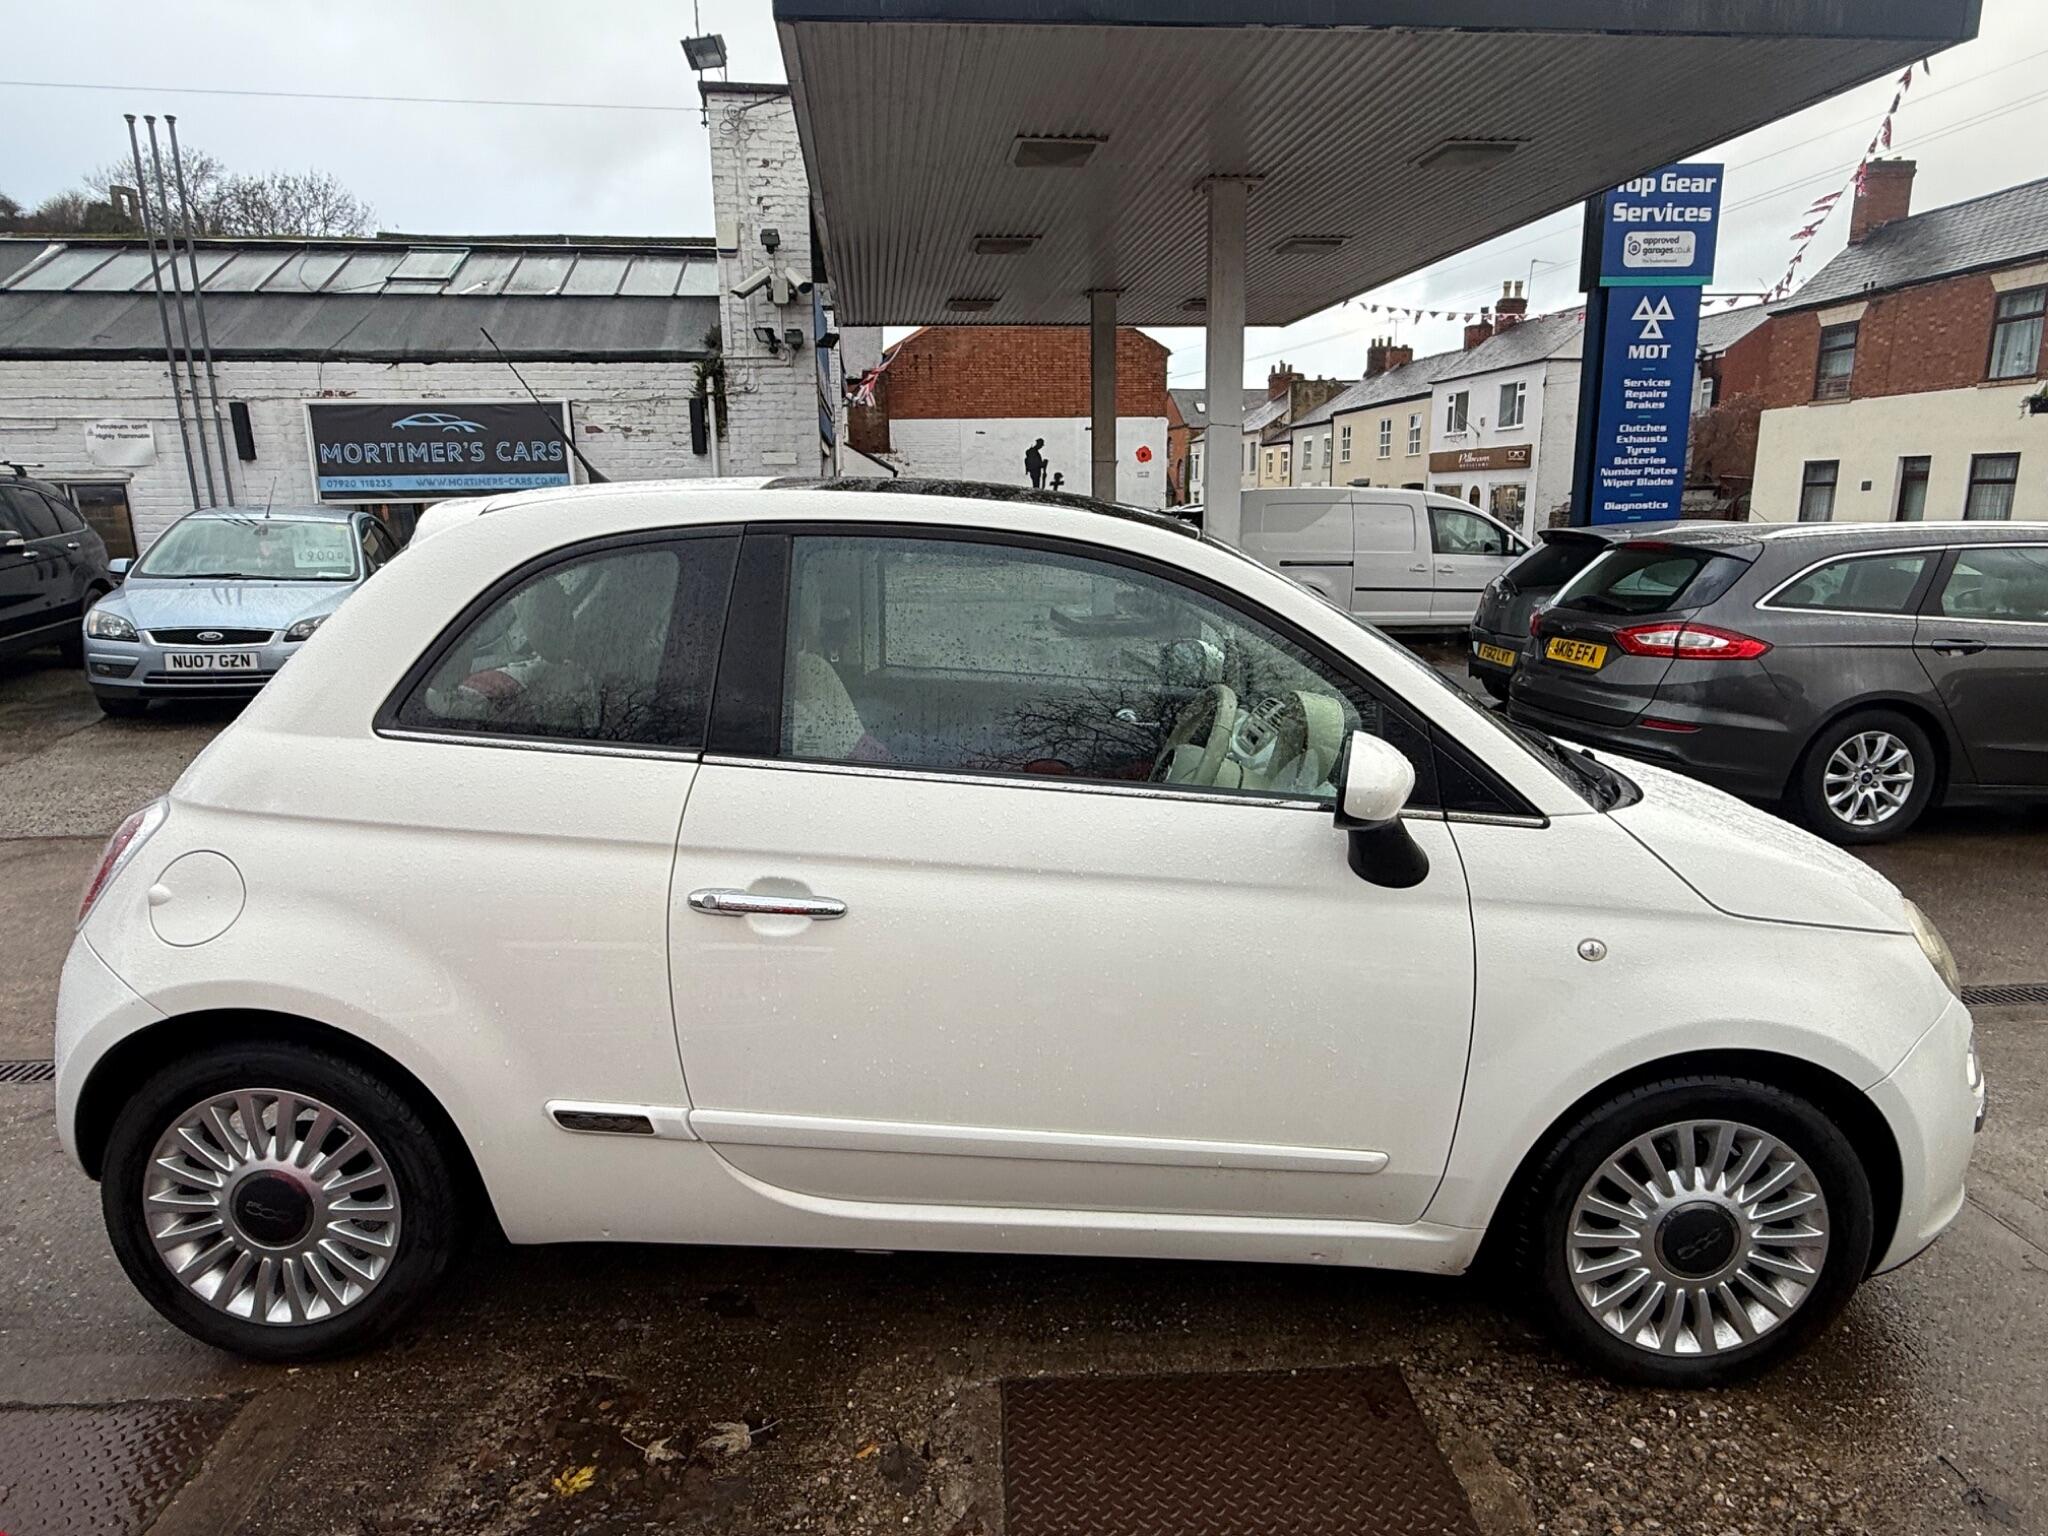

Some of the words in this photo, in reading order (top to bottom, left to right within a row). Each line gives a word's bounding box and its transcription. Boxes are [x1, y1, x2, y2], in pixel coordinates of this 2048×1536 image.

[1660, 173, 1717, 193] Gear
[1612, 202, 1713, 222] Services
[1642, 236, 1680, 246] approved
[1628, 344, 1672, 359] MOT
[1623, 378, 1671, 388] Services
[1624, 389, 1668, 399] Repairs
[1625, 400, 1665, 409] Brakes
[1619, 423, 1667, 433] Clutches
[1616, 434, 1668, 444] Exhausts
[319, 441, 486, 464] MORTIMER'S
[496, 441, 563, 462] CARS
[1626, 445, 1657, 456] Tyres
[1614, 456, 1667, 465] Batteries
[1600, 467, 1641, 476] Number
[1644, 466, 1678, 475] Plates
[326, 479, 356, 488] 07920
[1603, 478, 1634, 488] Wiper
[1636, 477, 1674, 486] Blades
[1604, 501, 1669, 511] Diagnostics
[1575, 643, 1598, 663] EFA
[172, 654, 213, 669] NU07
[219, 654, 251, 668] GZN
